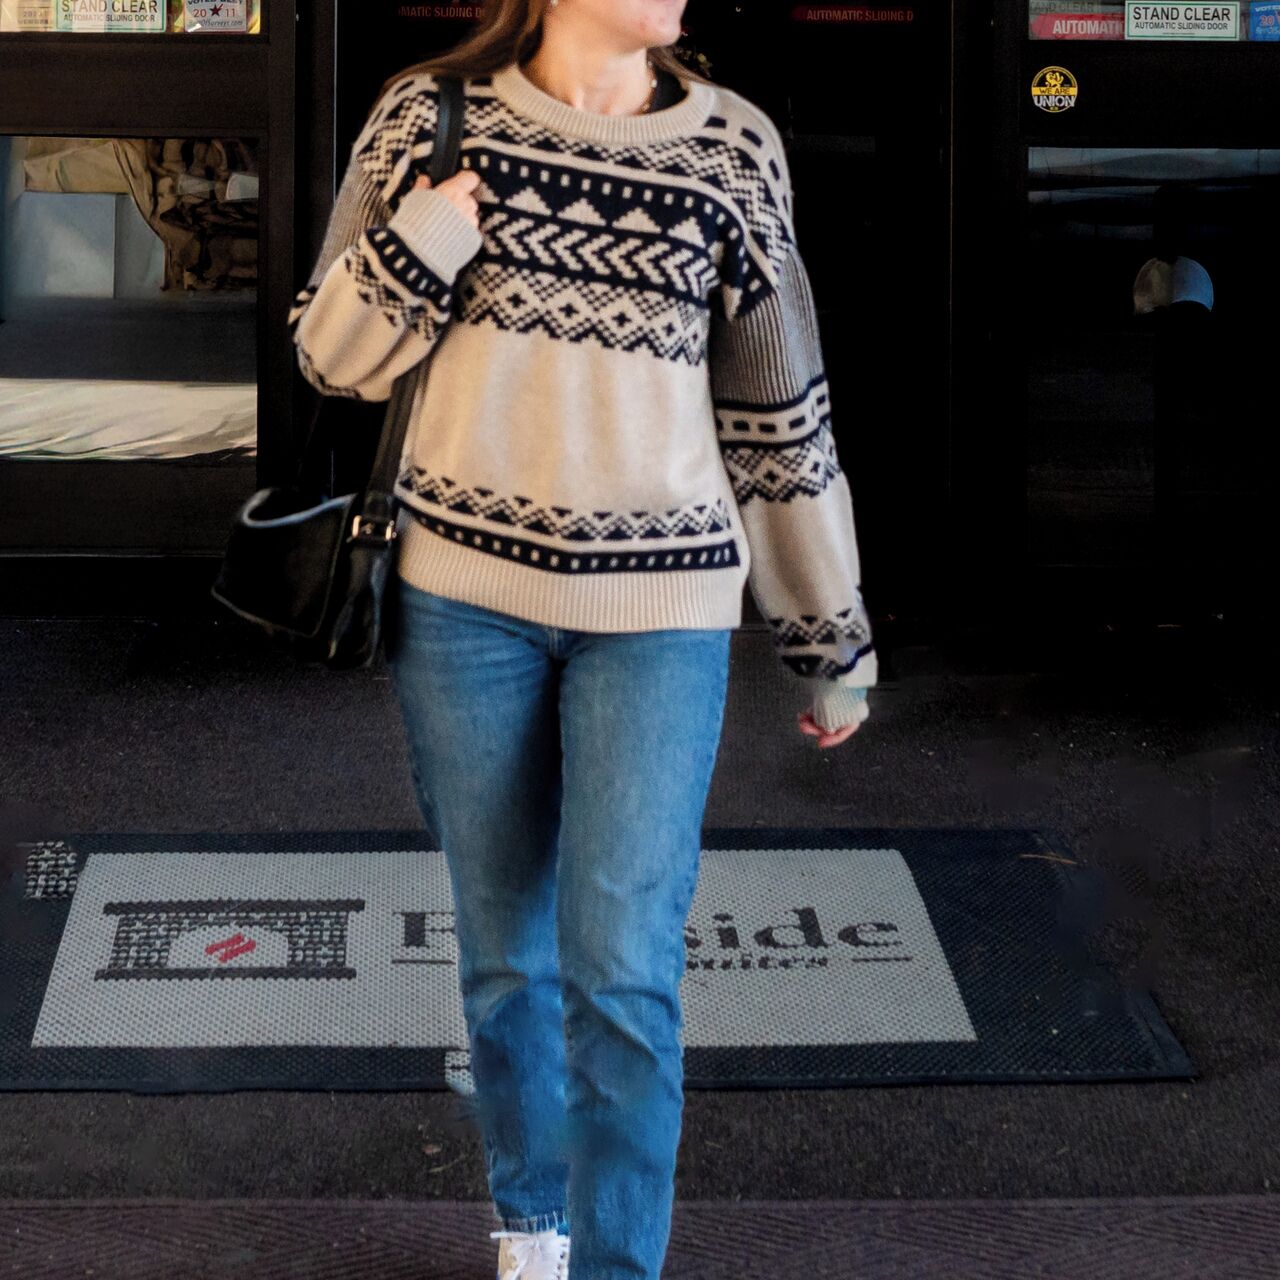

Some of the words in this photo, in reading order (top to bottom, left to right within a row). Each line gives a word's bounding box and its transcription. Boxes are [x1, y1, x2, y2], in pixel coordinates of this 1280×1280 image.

[111, 0, 158, 14] CLEAR
[193, 8, 207, 18] 20
[225, 8, 236, 17] 11
[63, 14, 105, 22] AUTOMATIC
[807, 9, 864, 21] AUTOMATIC
[865, 10, 905, 21] SLIDING
[1133, 6, 1180, 20] STAND
[1184, 7, 1231, 21] CLEAR
[1052, 20, 1125, 35] AUTOMATI
[1135, 22, 1176, 30] AUTOMATIC
[1177, 22, 1206, 30] SLIDING
[1039, 87, 1053, 95] WE
[1055, 87, 1071, 95] ARE
[1033, 95, 1075, 107] UNION
